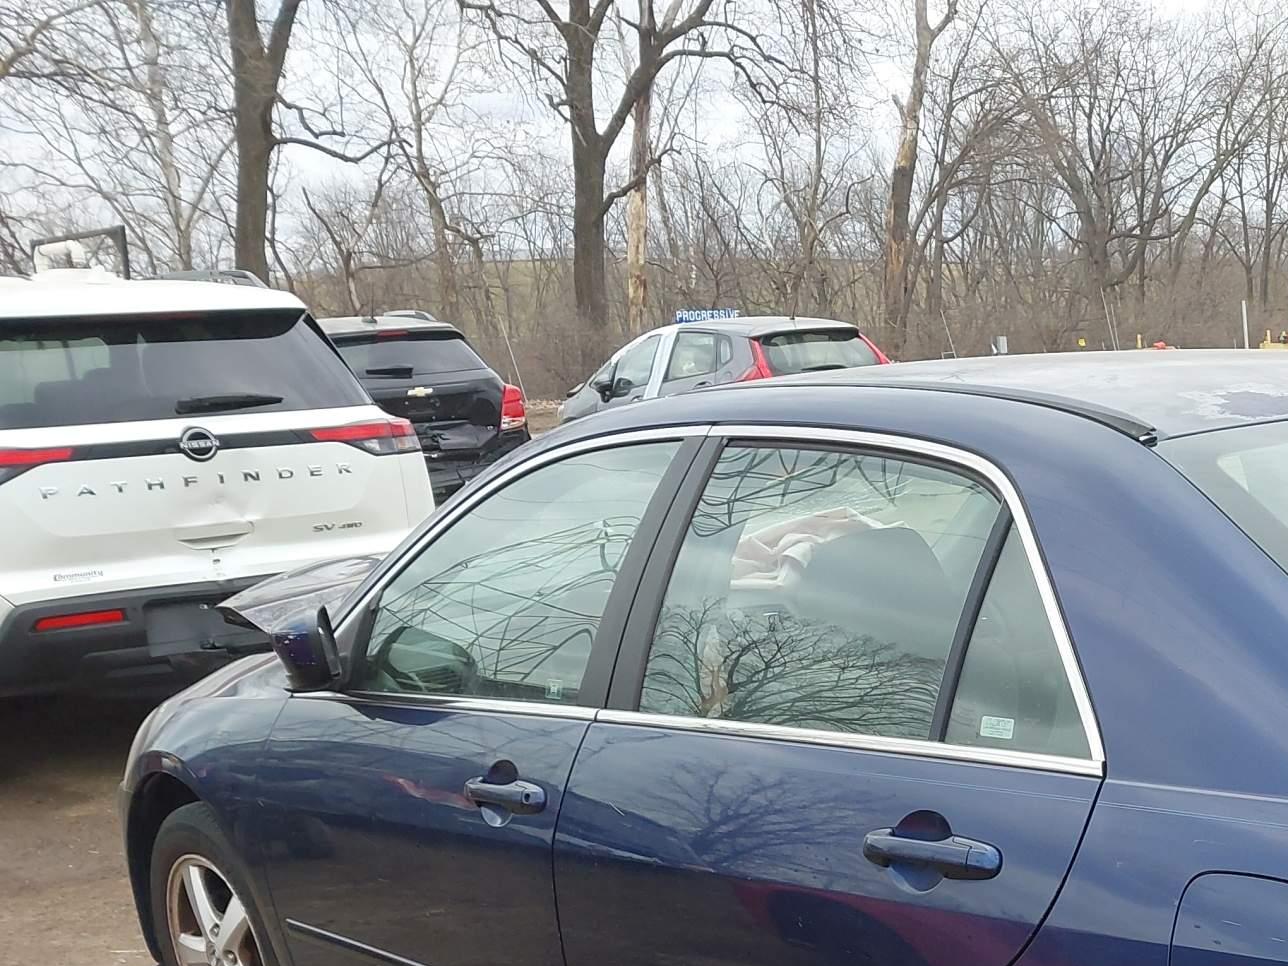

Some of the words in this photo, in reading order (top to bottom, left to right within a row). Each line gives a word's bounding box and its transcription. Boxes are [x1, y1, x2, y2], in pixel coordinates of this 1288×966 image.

[676, 308, 740, 322] PROGRESSIVE
[39, 462, 353, 499] PATHFINDER
[312, 523, 335, 532] SV
